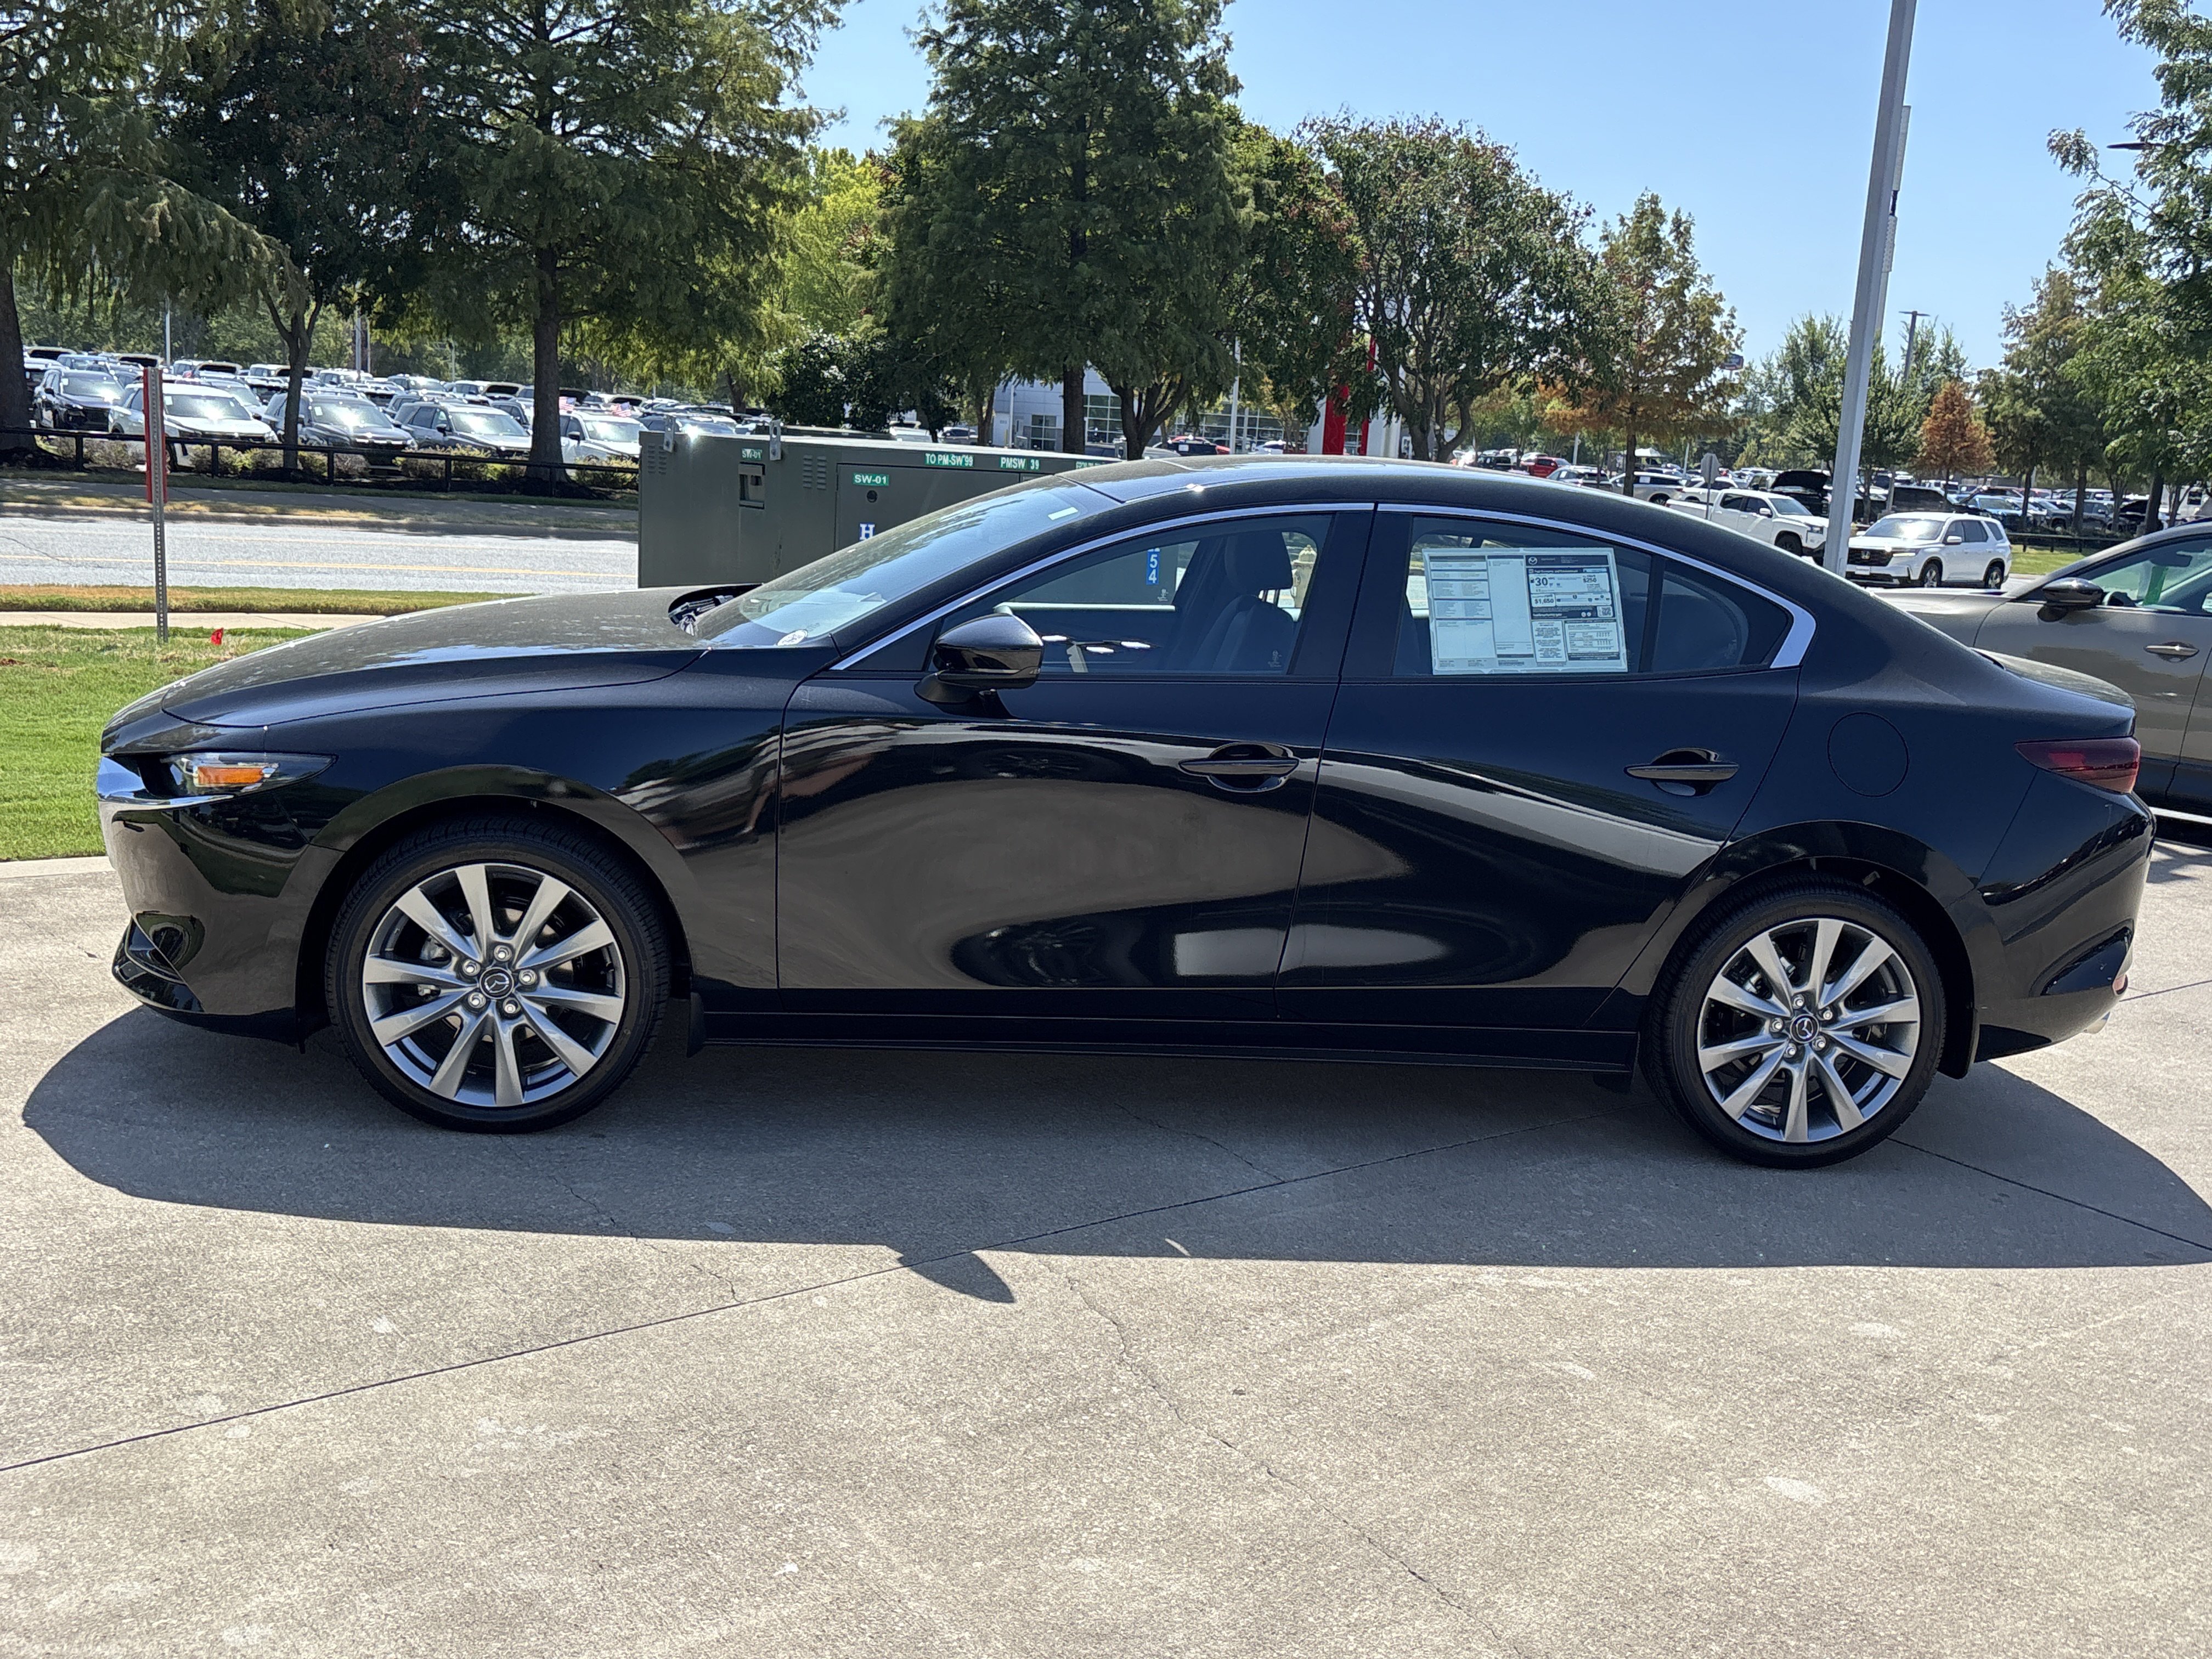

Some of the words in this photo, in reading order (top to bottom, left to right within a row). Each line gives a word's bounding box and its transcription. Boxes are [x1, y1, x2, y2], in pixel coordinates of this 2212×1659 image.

[925, 453, 936, 464] TO
[1000, 457, 1026, 469] PMSW
[1030, 459, 1040, 470] 39
[854, 474, 887, 484] SW-01
[859, 523, 875, 540] H
[1535, 577, 1548, 586] 30
